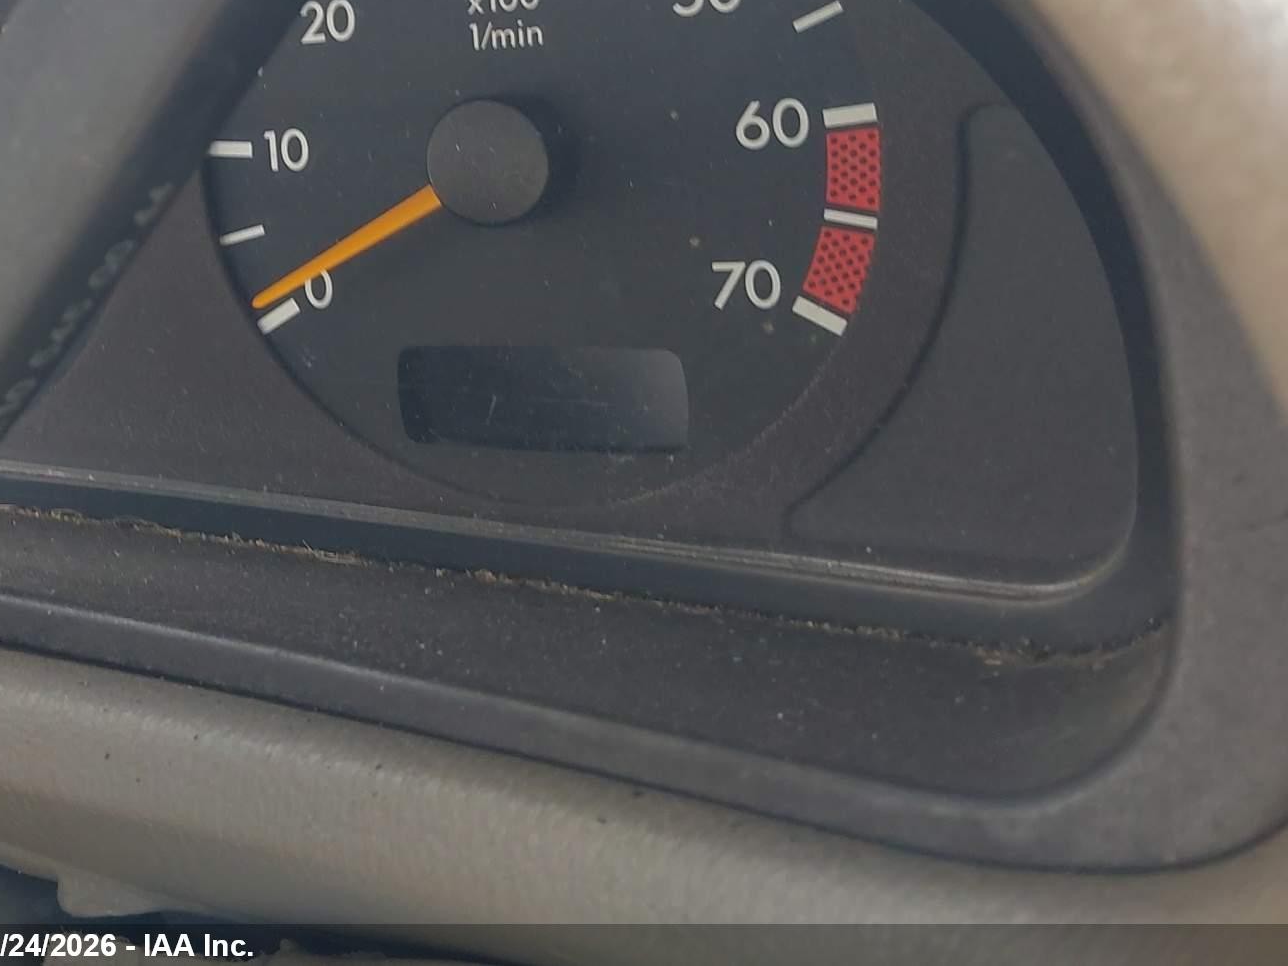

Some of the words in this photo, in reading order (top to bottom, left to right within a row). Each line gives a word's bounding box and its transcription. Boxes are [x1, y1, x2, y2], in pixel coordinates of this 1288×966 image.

[470, 21, 543, 50] 1/min
[735, 98, 809, 148] 60
[263, 128, 310, 172] 10
[305, 270, 333, 309] 0
[711, 260, 781, 310] 70
